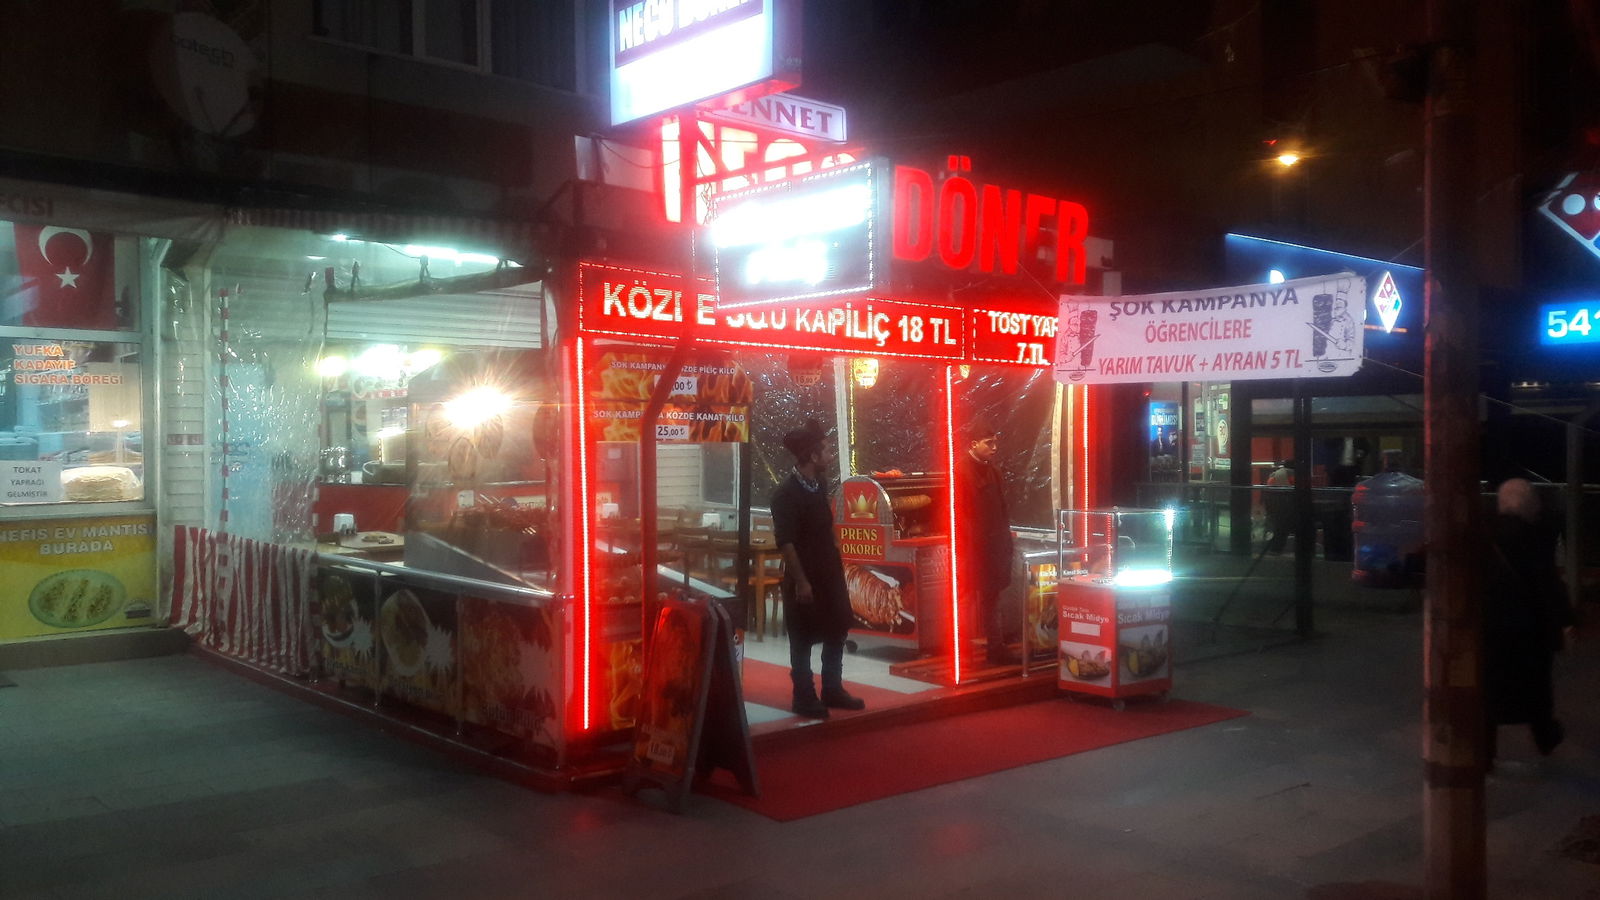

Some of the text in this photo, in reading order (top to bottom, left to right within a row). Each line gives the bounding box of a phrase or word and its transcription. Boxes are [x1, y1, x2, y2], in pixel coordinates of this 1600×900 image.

[1161, 286, 1299, 315] KAMPANYA
[988, 310, 1031, 335] TOST
[898, 315, 924, 343] 18
[929, 317, 957, 345] TL
[1145, 318, 1253, 344] ÖĞRENCİLERE
[12, 344, 64, 357] YUFKA
[14, 360, 76, 371] KADAYIF
[1099, 354, 1144, 376] YARIM
[1146, 353, 1195, 374] TAVUK
[1213, 352, 1269, 370] AYRAN
[1271, 351, 1281, 367] 5
[1285, 350, 1303, 369] TL
[696, 412, 722, 421] KANAT
[657, 426, 679, 437] 25,00
[12, 466, 41, 474] TOKAT
[54, 528, 76, 539] EV
[840, 527, 878, 541] PRENS
[40, 540, 113, 555] BURADA
